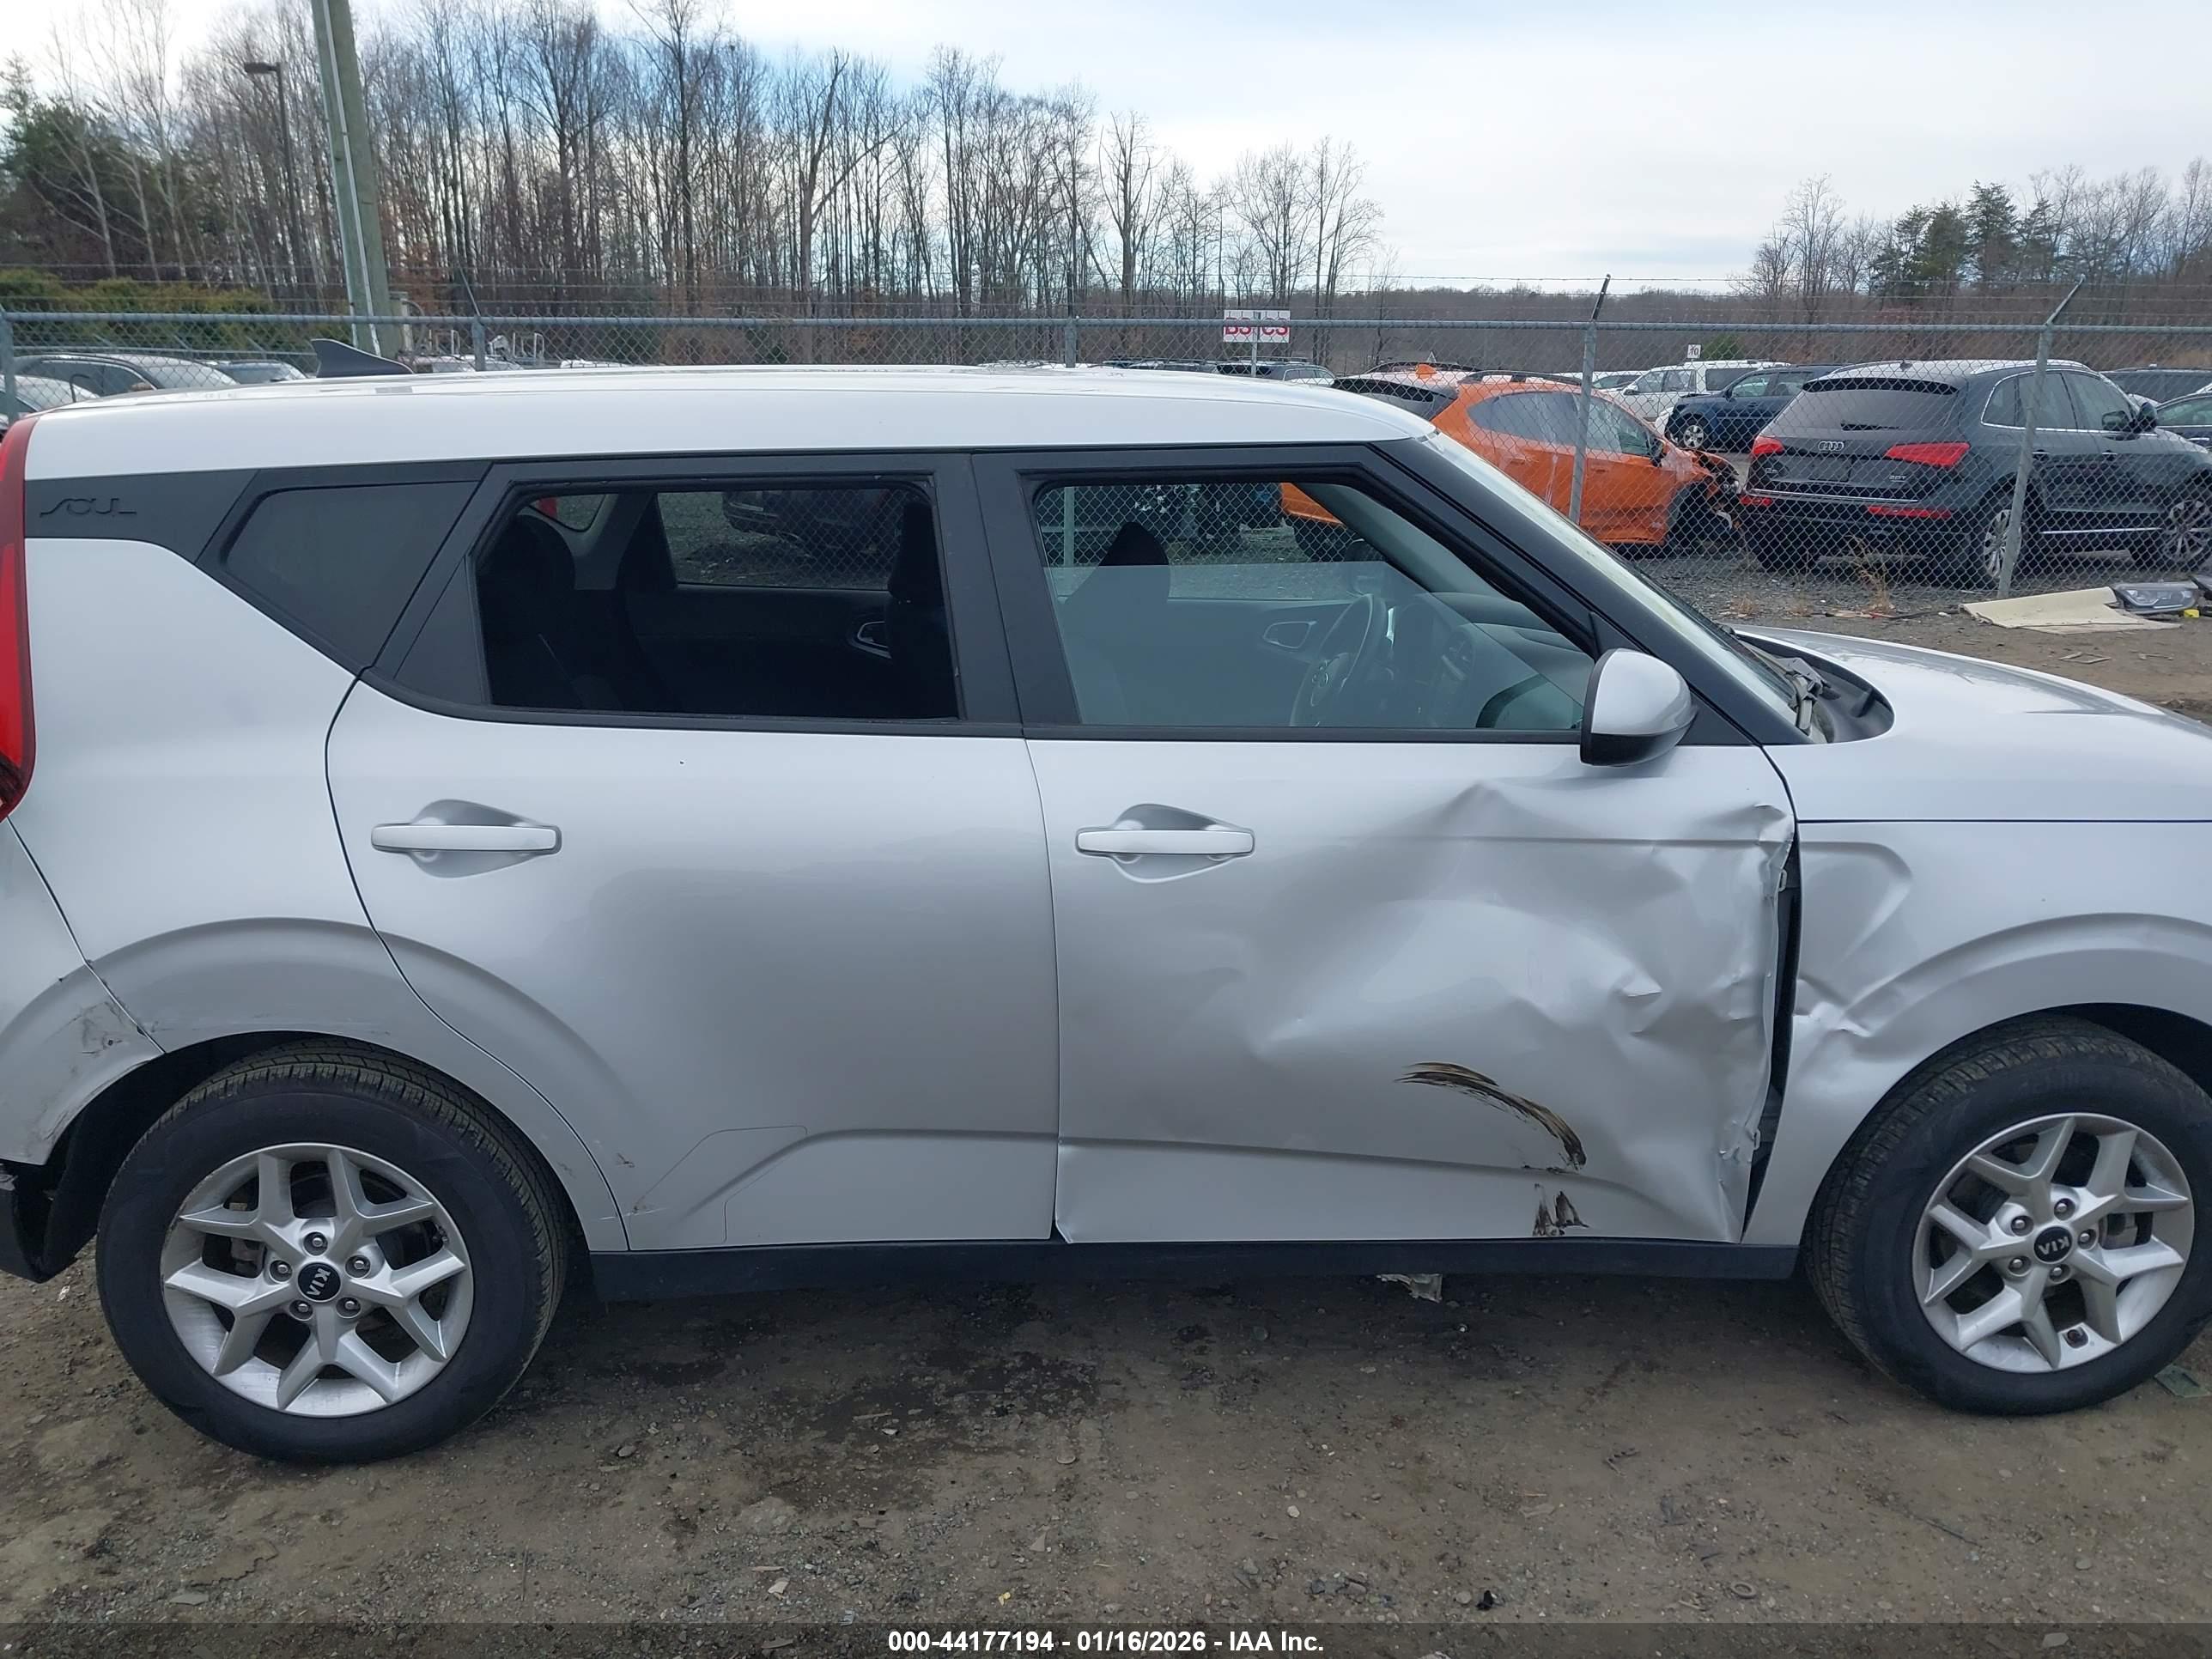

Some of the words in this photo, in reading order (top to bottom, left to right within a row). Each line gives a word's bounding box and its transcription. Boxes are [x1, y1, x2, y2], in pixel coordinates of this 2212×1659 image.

[40, 497, 137, 517] SOUL
[2038, 1236, 2069, 1255] KIA
[302, 1267, 331, 1296] KIA
